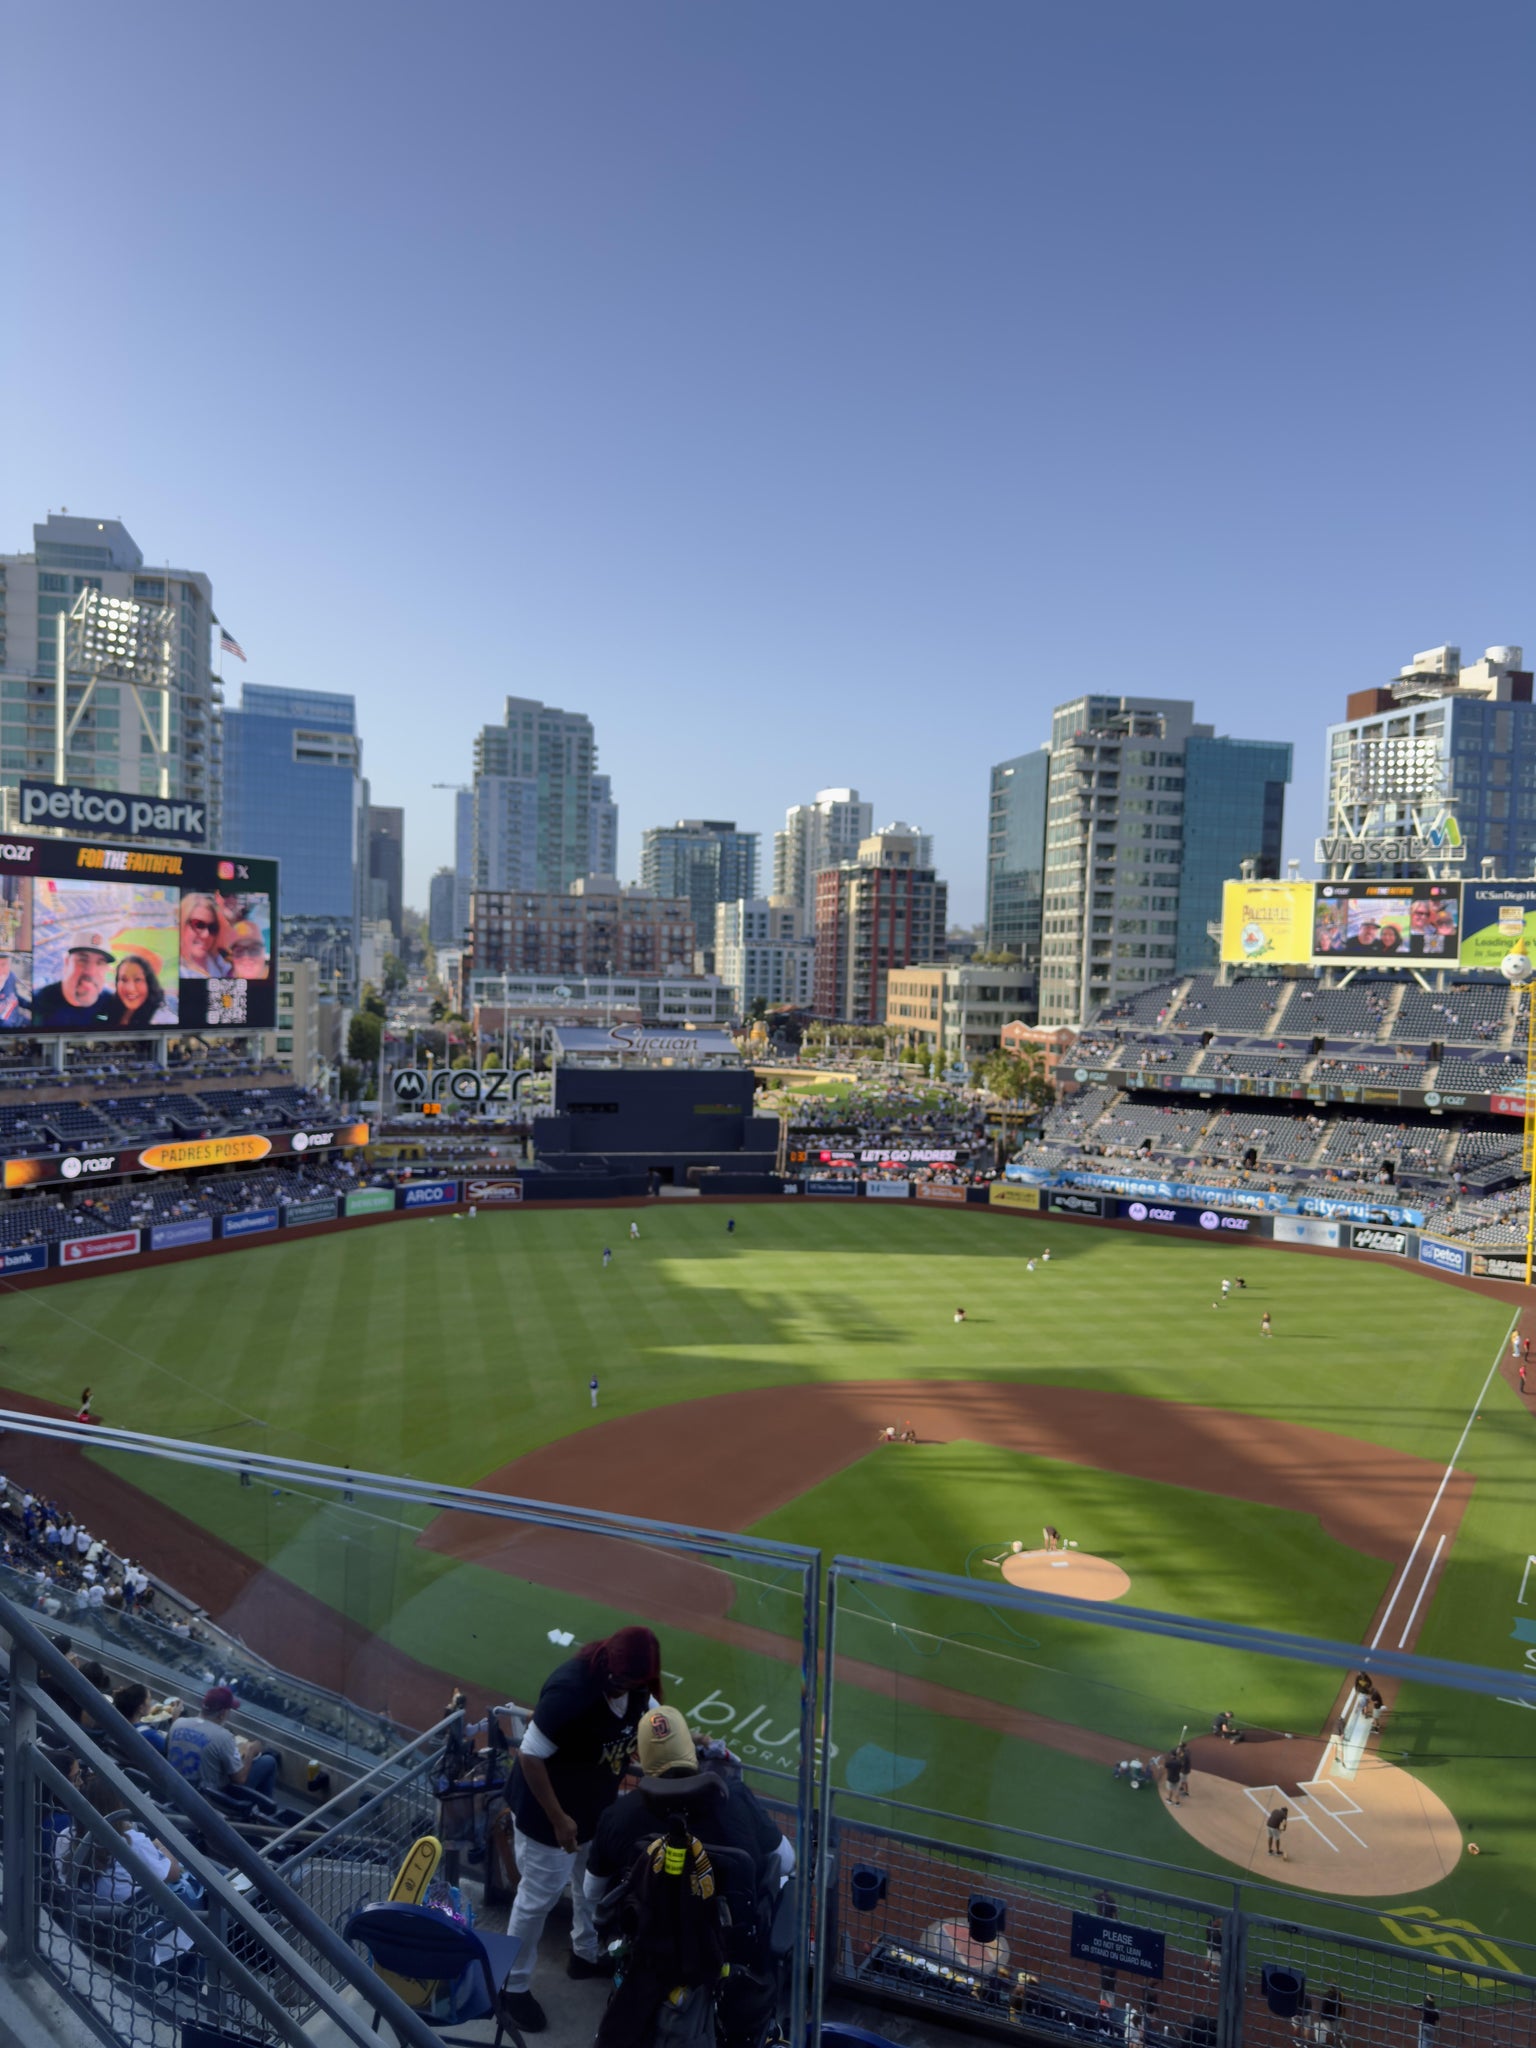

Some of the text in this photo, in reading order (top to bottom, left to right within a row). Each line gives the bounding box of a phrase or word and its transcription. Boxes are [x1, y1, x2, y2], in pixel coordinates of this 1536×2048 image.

[23, 787, 204, 834] petco park
[1320, 838, 1417, 861] Viasat
[608, 1023, 698, 1056] Sycuan
[431, 1070, 532, 1101] razr
[161, 1142, 254, 1163] PADRES POSTS
[861, 1150, 957, 1161] LET'S GO PADRES!
[82, 1157, 115, 1172] razr
[406, 1187, 443, 1203] ARCO
[227, 1215, 269, 1230] Southwest
[1149, 1208, 1176, 1221] razr
[1220, 1215, 1250, 1230] razr
[5, 1253, 32, 1265] bank
[1433, 1247, 1462, 1263] petco
[1102, 1929, 1133, 1946] PLEASE
[1081, 1944, 1090, 1952] OR
[1090, 1946, 1109, 1958] STAND
[1110, 1951, 1119, 1961] ON
[1119, 1954, 1139, 1966] GUARD
[1093, 1938, 1102, 1946] DO
[1103, 1941, 1114, 1950] NOT
[1126, 1946, 1141, 1957] LEAN
